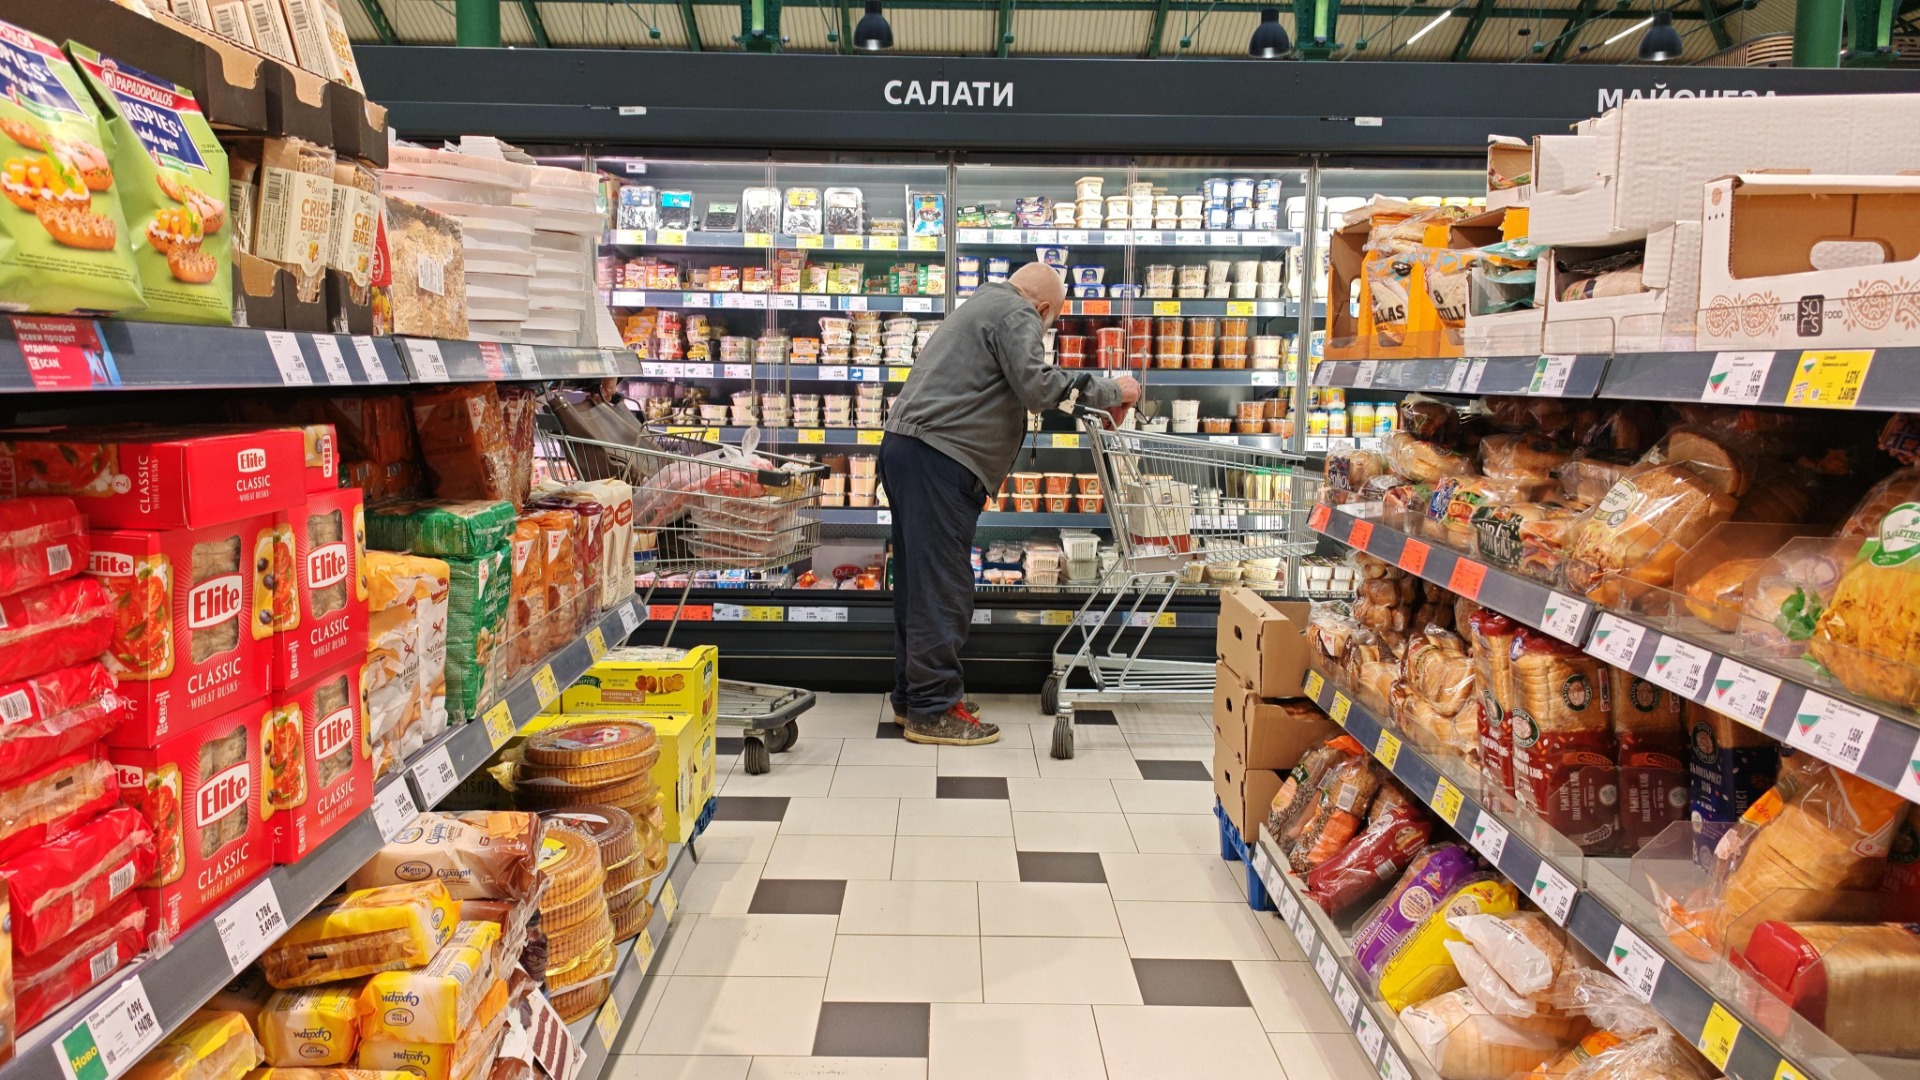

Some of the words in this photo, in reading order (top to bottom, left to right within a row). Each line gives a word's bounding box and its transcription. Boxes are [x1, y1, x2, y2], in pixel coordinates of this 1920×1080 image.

[115, 76, 174, 107] PAPADOPOULOS
[884, 80, 1014, 107] САЛАТИ
[301, 198, 330, 217] CRISP
[300, 216, 329, 234] BREAD
[1434, 290, 1443, 305] 8
[1375, 304, 1405, 326] LLAS
[1779, 312, 1796, 322] SAR'S
[1824, 310, 1843, 320] FOOD
[13, 319, 40, 333] Моля,
[41, 320, 76, 334] сканирай
[19, 333, 43, 343] всеки
[44, 334, 76, 345] продукт
[24, 344, 60, 355] отделно.
[40, 357, 60, 369] SCAN
[240, 454, 265, 470] Elite
[138, 455, 151, 514] CLASSIC
[236, 475, 271, 493] CLASSIC
[88, 554, 131, 575] Elite
[311, 552, 346, 585] Elite
[193, 584, 240, 624] Elite
[310, 615, 350, 645] CLASSIC
[187, 658, 241, 695] CLASSIC
[317, 719, 351, 756] Elite
[116, 767, 141, 785] ite
[201, 775, 248, 822] Elite
[317, 777, 355, 815] CLASSIC
[197, 843, 249, 890] CLASSIC
[436, 868, 472, 879] Сухари
[256, 902, 272, 922] 1.78€
[217, 918, 227, 928] Elite
[220, 921, 236, 936] Сухари
[381, 990, 420, 1007] Сухари
[127, 997, 144, 1021] 0.99€
[293, 1026, 332, 1042] Сухари
[71, 1046, 98, 1073] Ново
[393, 1049, 431, 1065] Сухари
